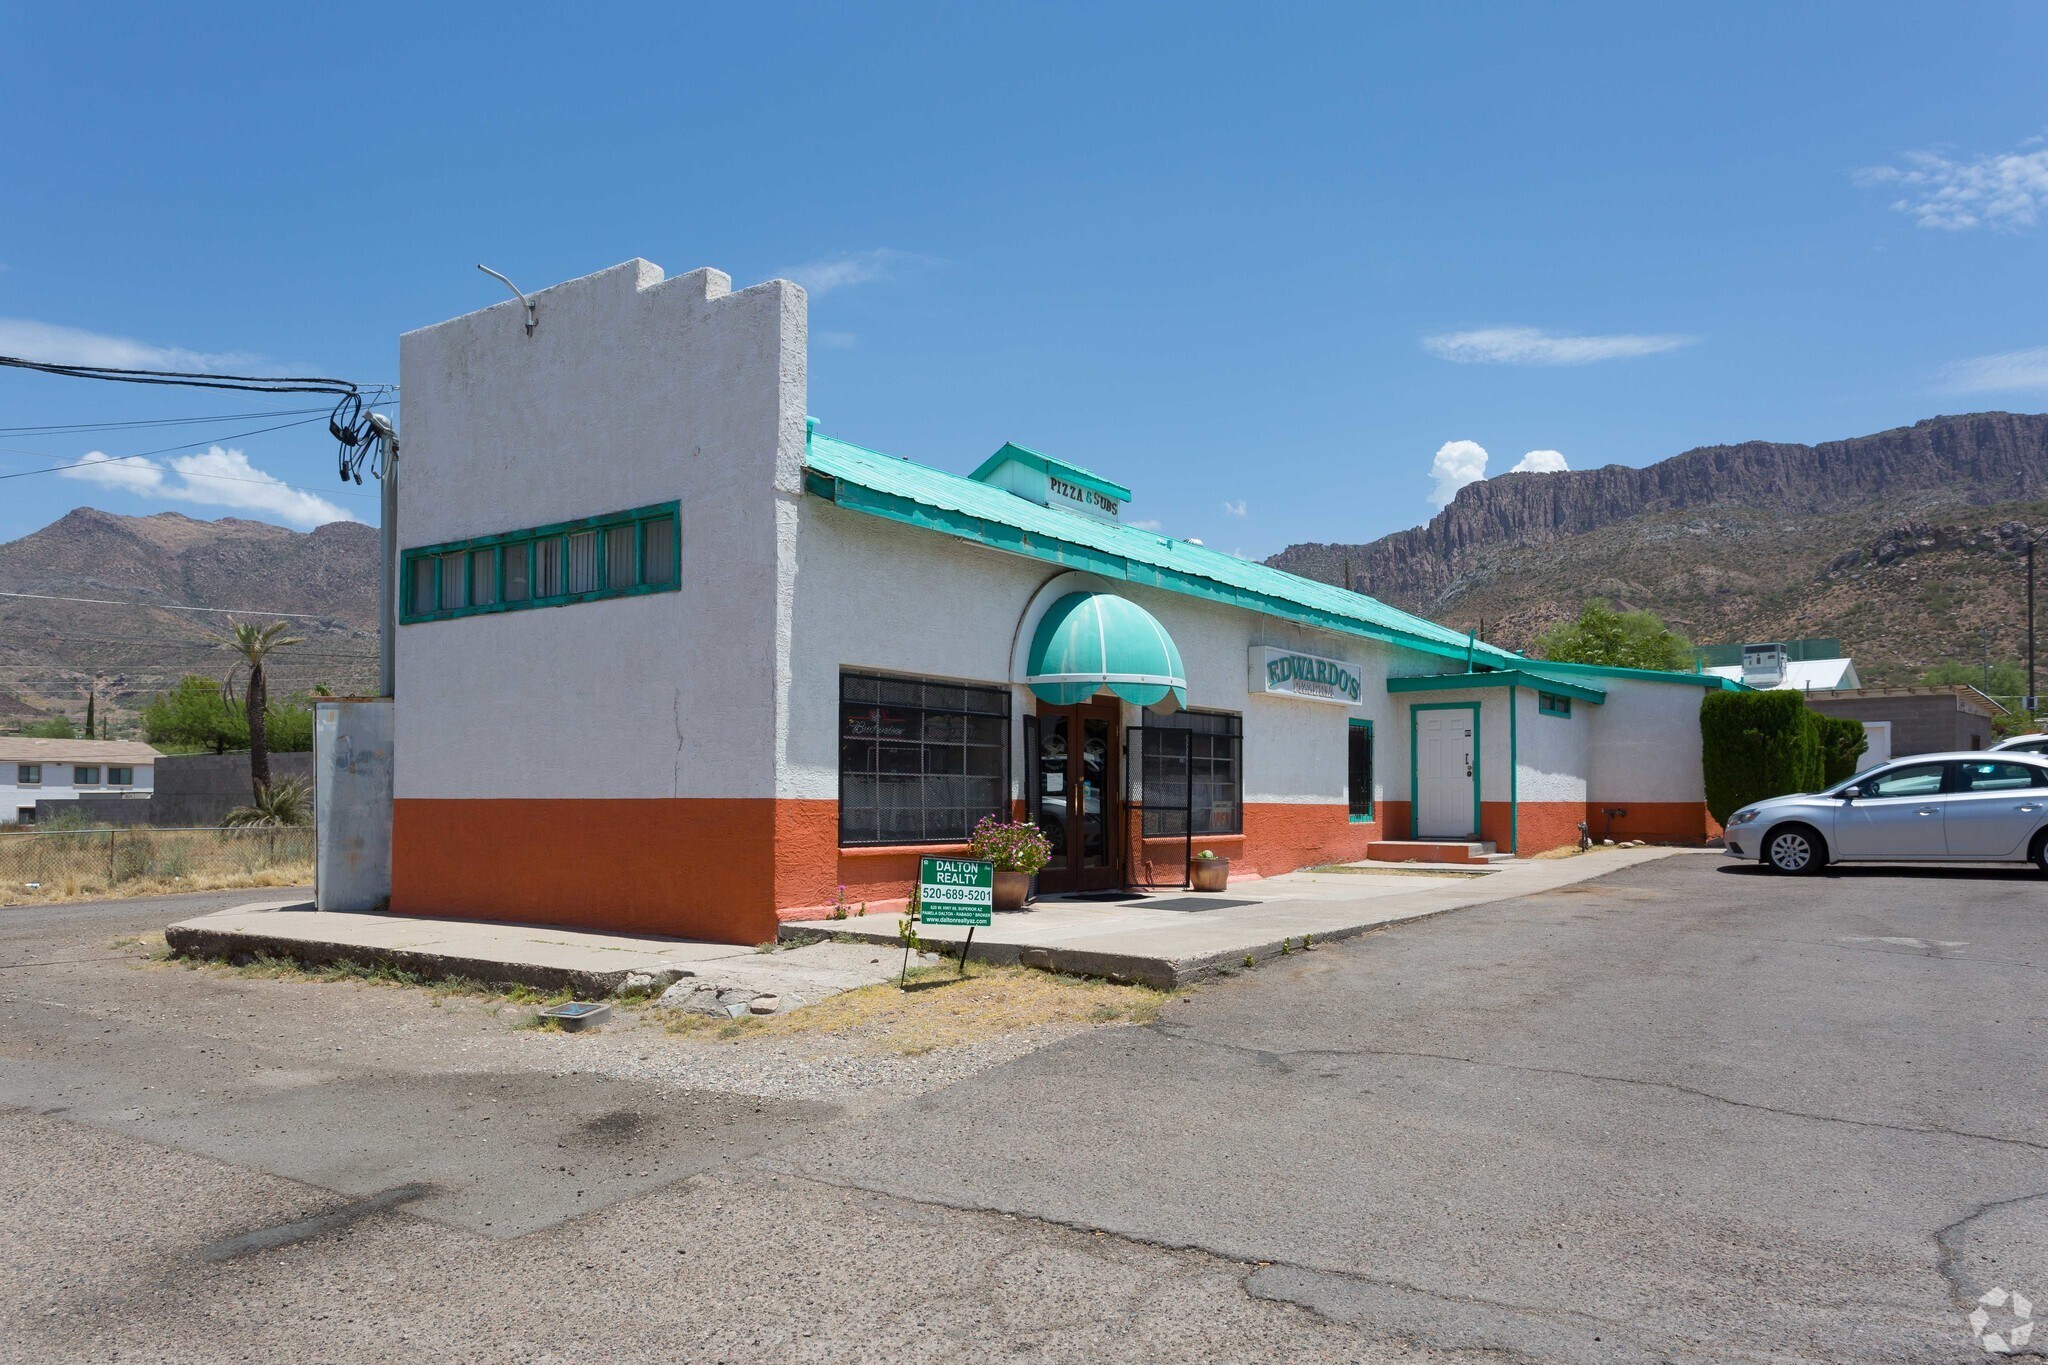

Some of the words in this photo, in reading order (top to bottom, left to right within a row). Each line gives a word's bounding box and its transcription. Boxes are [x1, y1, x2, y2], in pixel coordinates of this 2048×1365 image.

[1051, 478, 1083, 502] PIZZA
[1085, 491, 1092, 504] &
[1094, 493, 1117, 515] SUBS
[1267, 656, 1360, 700] EDWARDO'S
[936, 861, 978, 873] DALTON
[937, 872, 977, 884] REALTY
[923, 888, 991, 901] 520-689-5201
